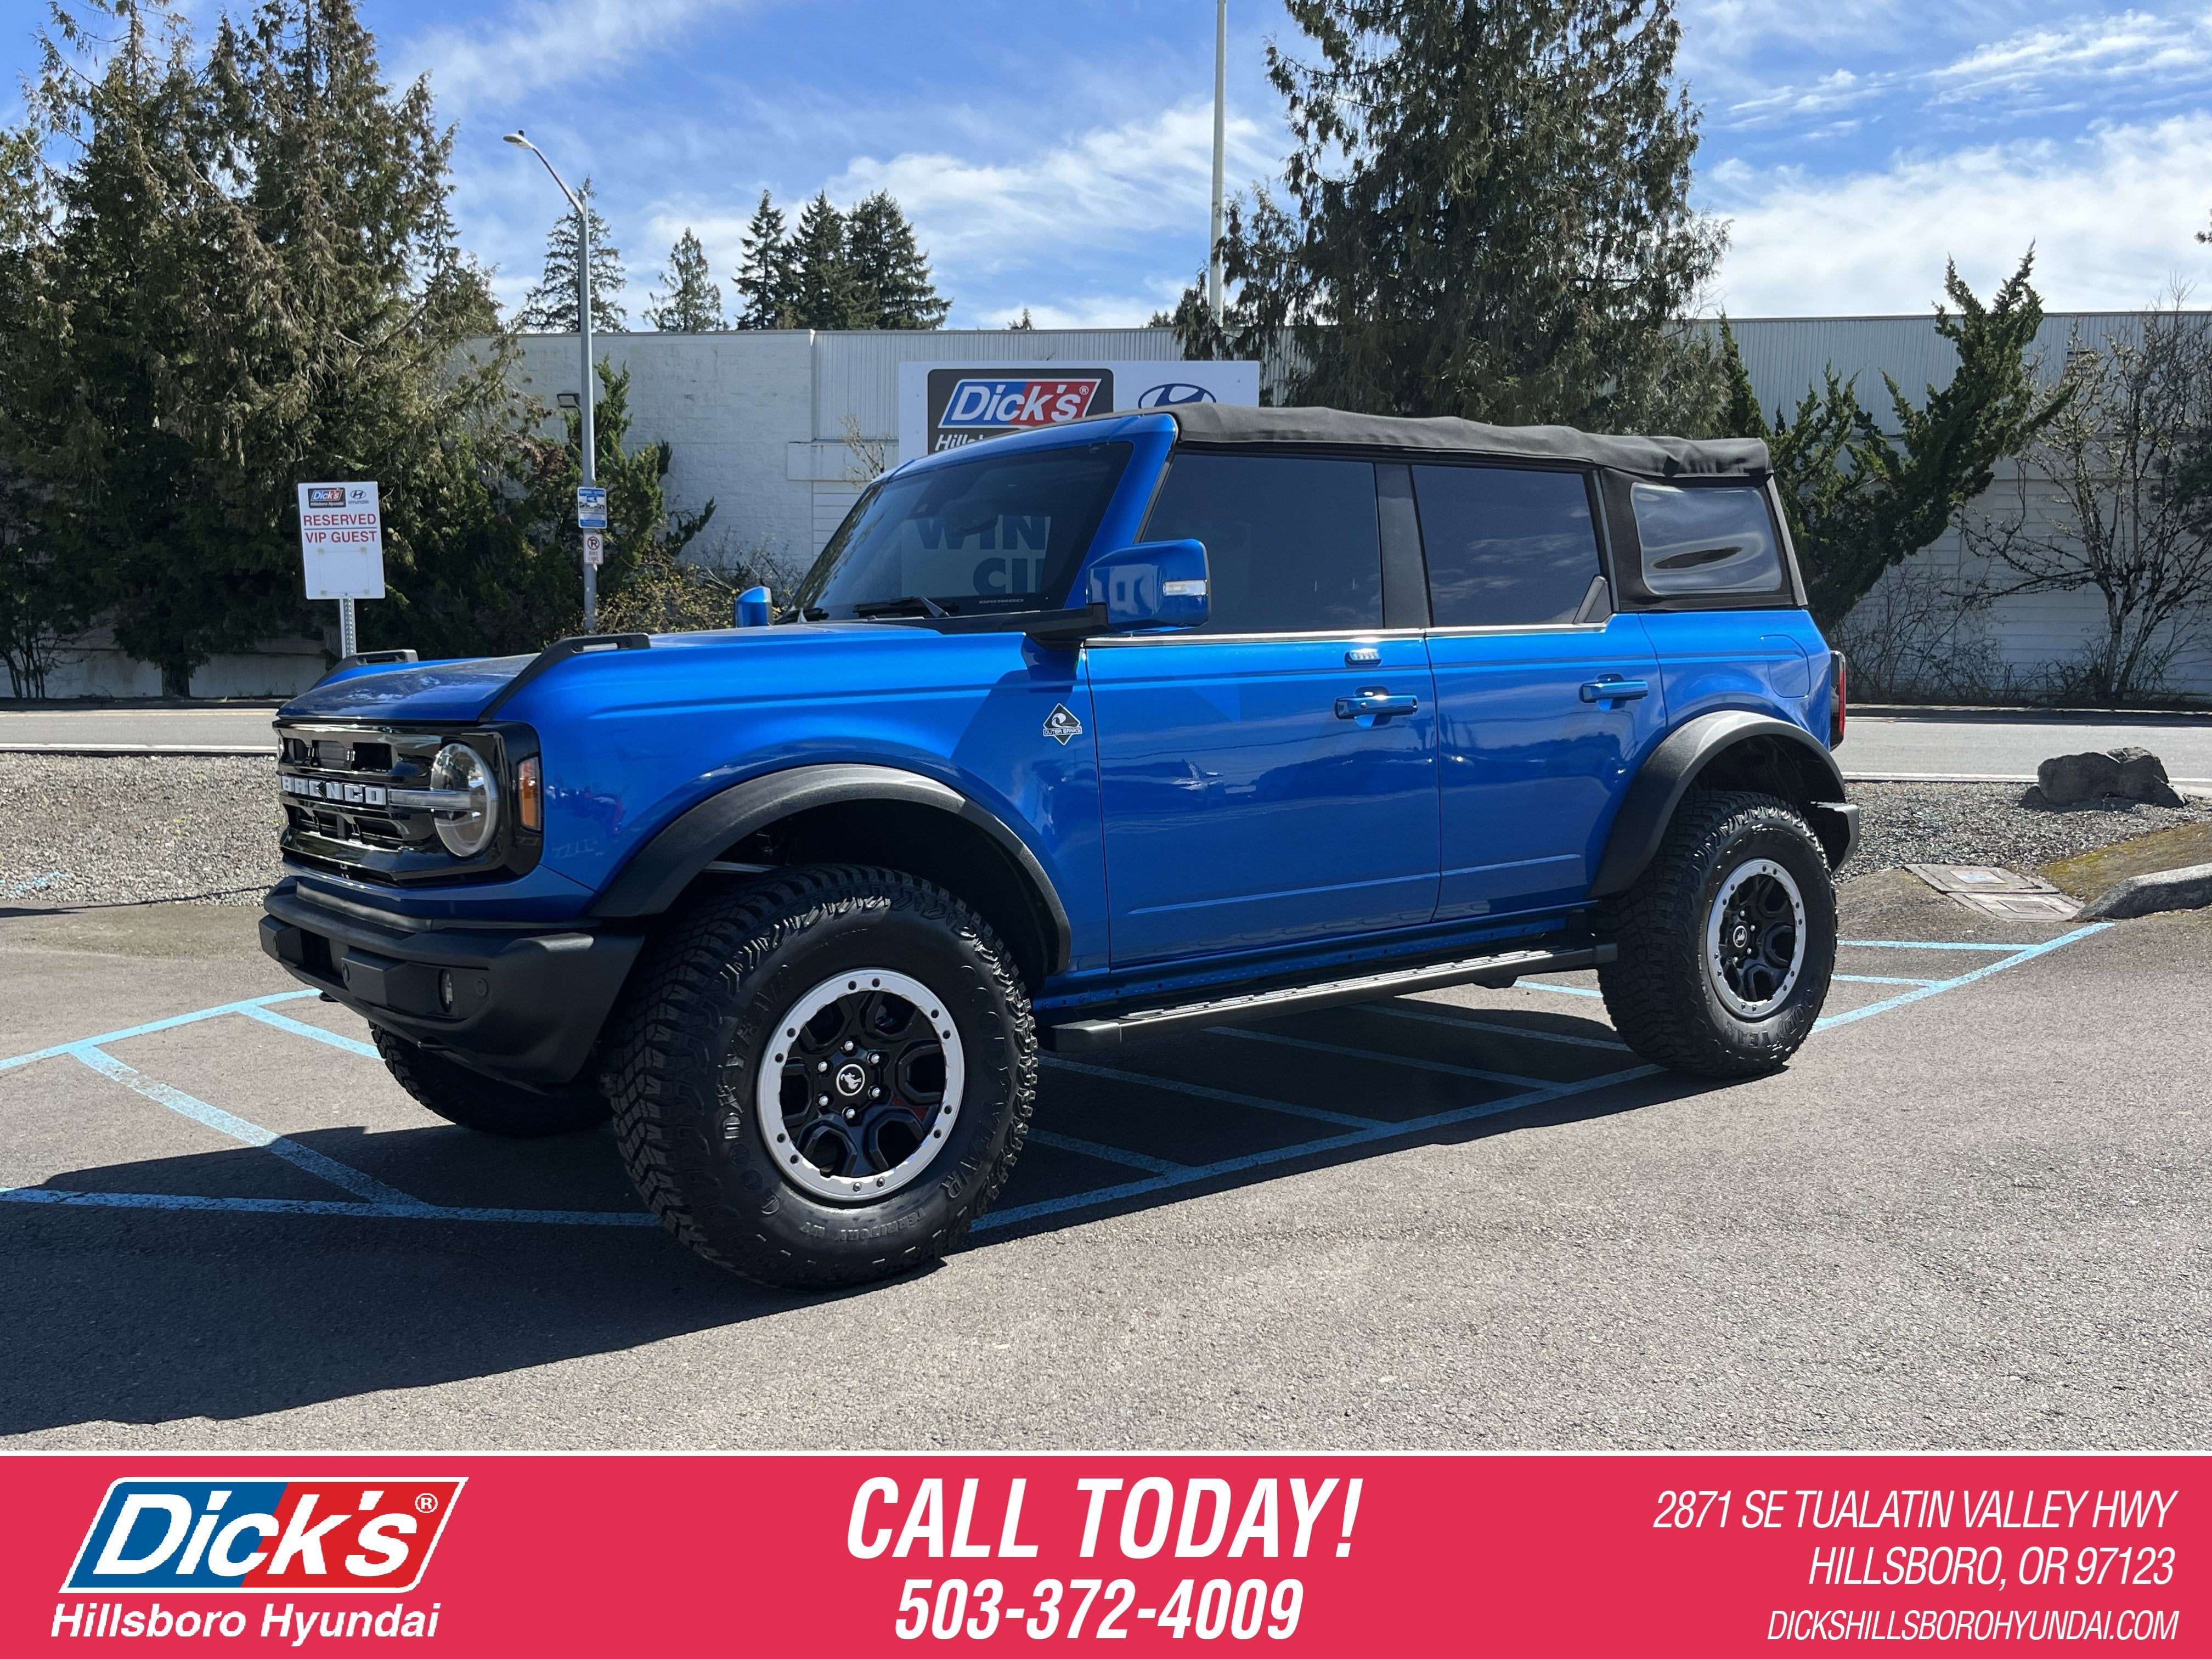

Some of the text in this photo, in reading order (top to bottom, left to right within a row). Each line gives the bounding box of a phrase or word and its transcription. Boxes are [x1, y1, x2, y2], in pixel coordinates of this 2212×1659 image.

[951, 385, 1081, 422] Dick's
[935, 435, 984, 451] Hill
[303, 514, 376, 526] RESERVED
[305, 531, 377, 543] VIP GUEST
[282, 775, 387, 806] BRONCO
